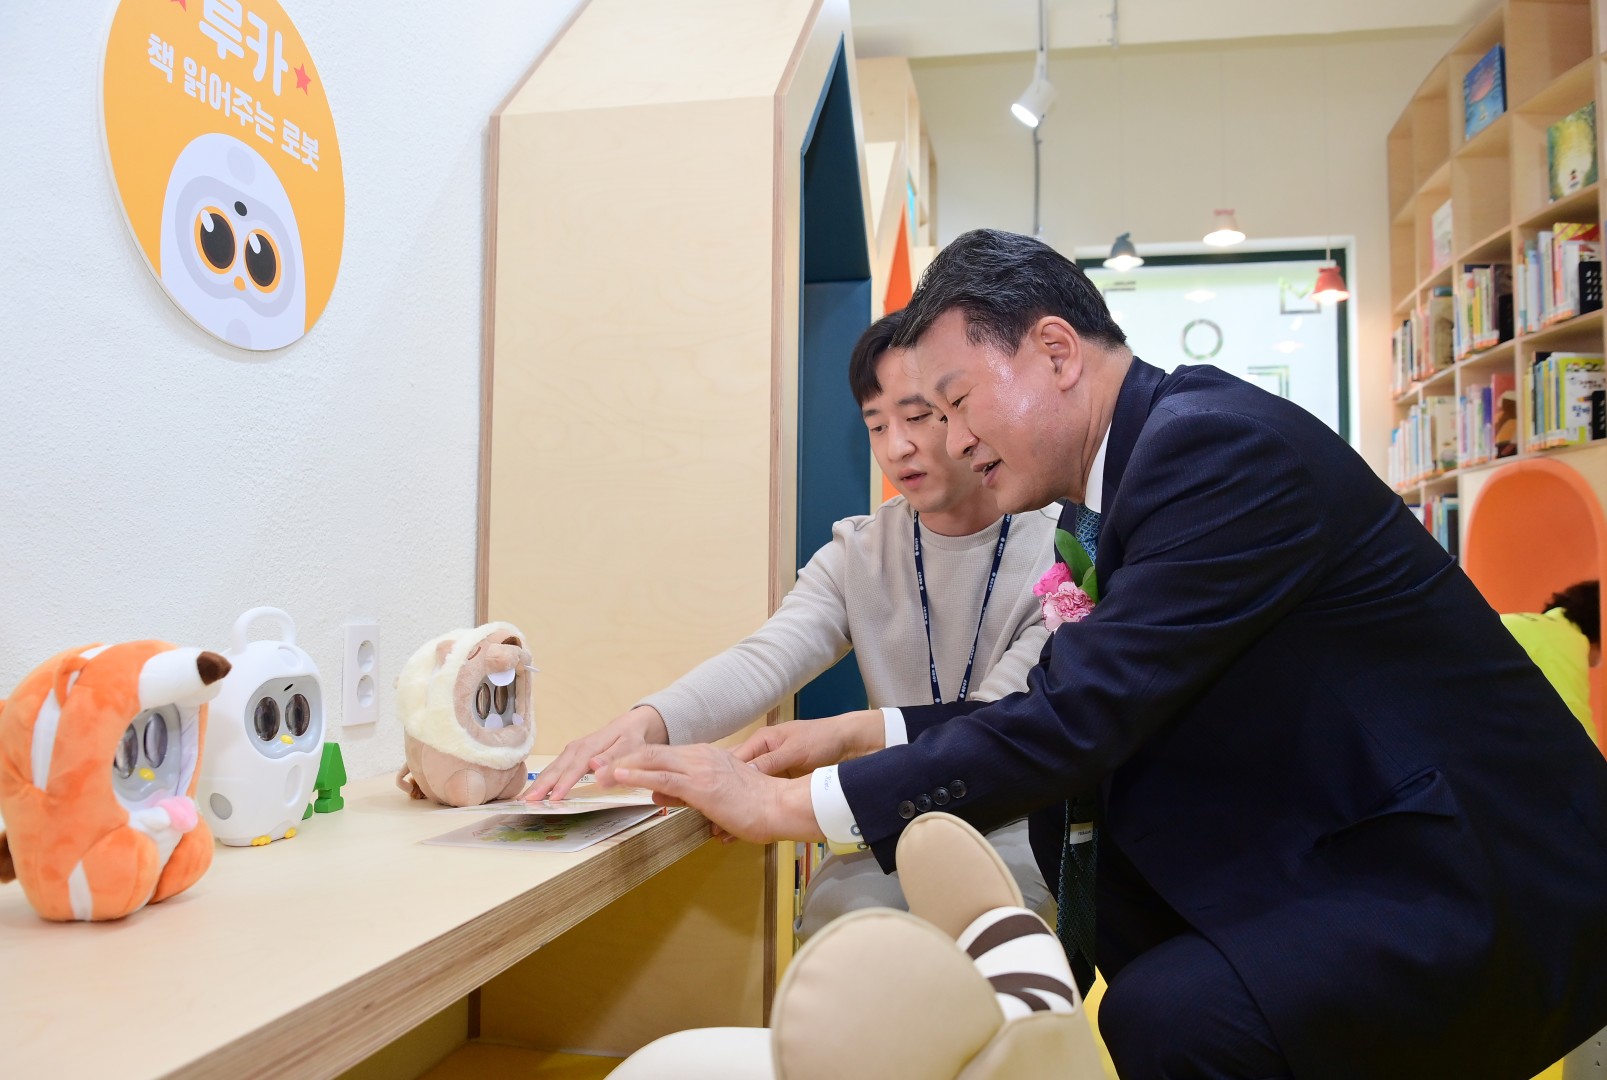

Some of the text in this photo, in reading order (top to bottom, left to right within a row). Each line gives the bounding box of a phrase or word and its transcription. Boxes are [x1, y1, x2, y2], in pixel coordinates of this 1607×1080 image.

[148, 34, 320, 171] 책 읽어주는 로봇
[199, 0, 288, 96] 루카
